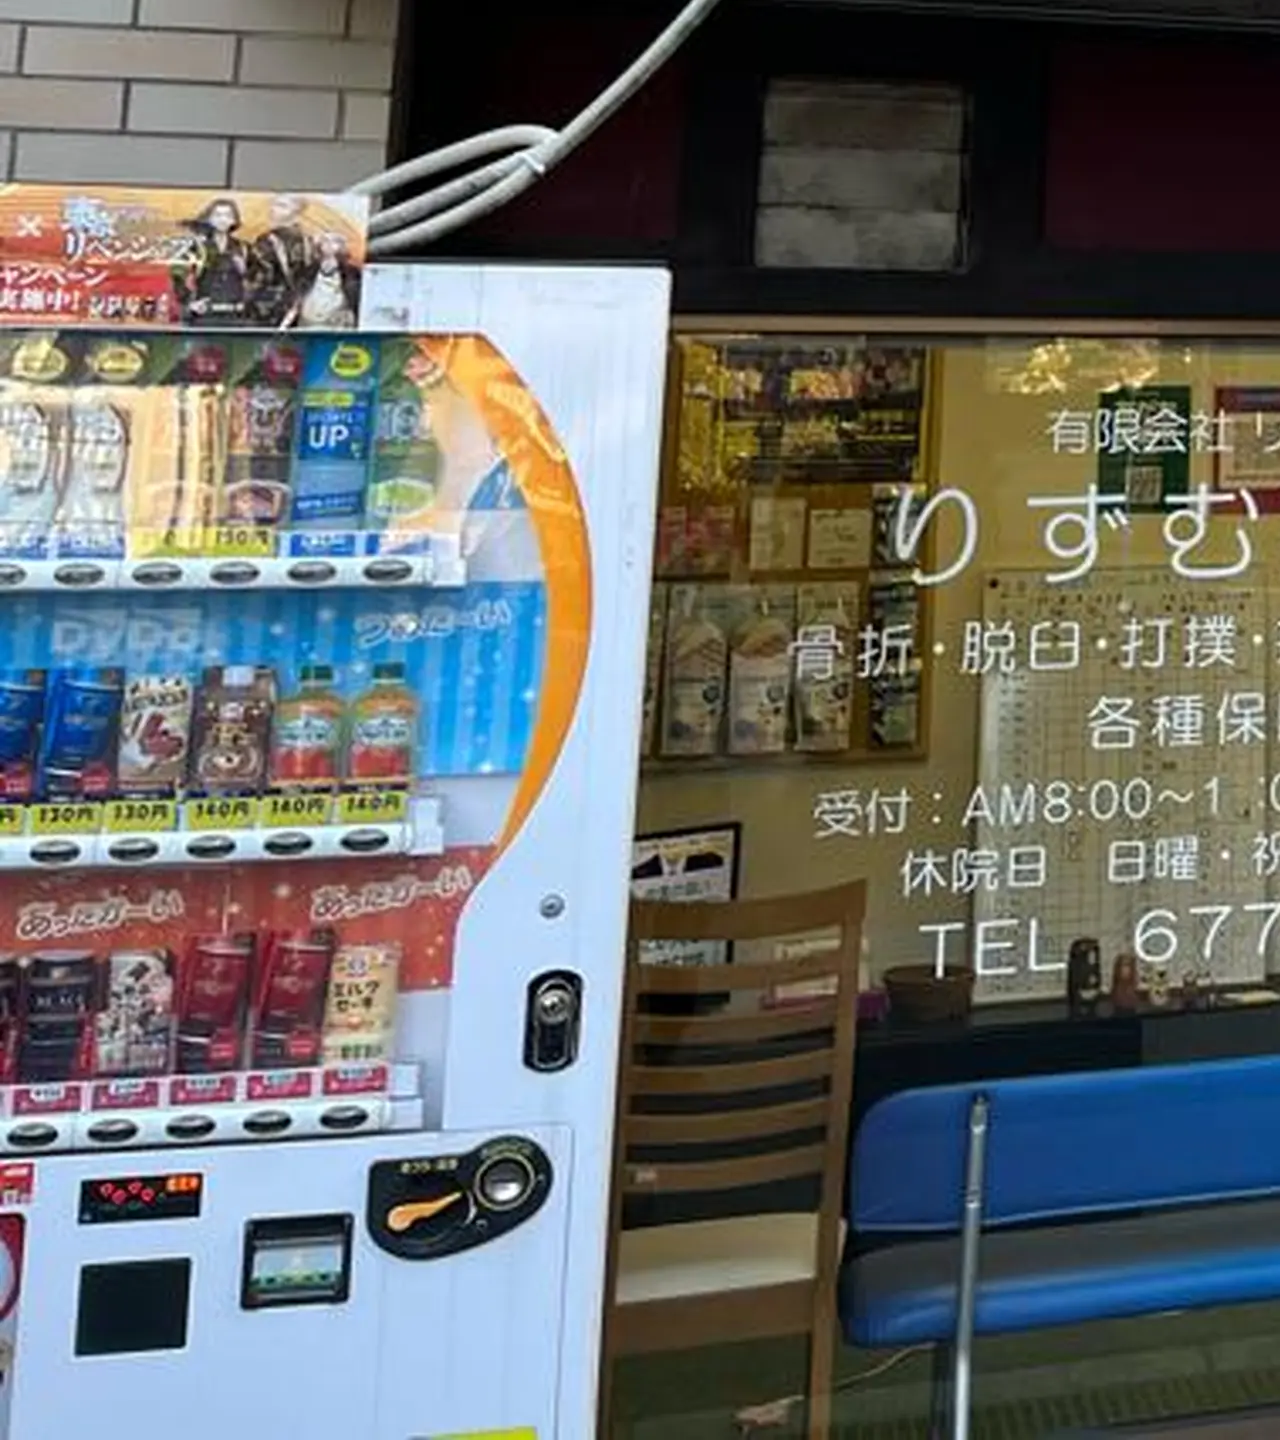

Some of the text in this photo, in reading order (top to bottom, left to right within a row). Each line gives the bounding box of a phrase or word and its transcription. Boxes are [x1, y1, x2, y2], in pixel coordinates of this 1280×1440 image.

[900, 844, 1047, 897] 休院日
[918, 918, 1068, 980] TEL
